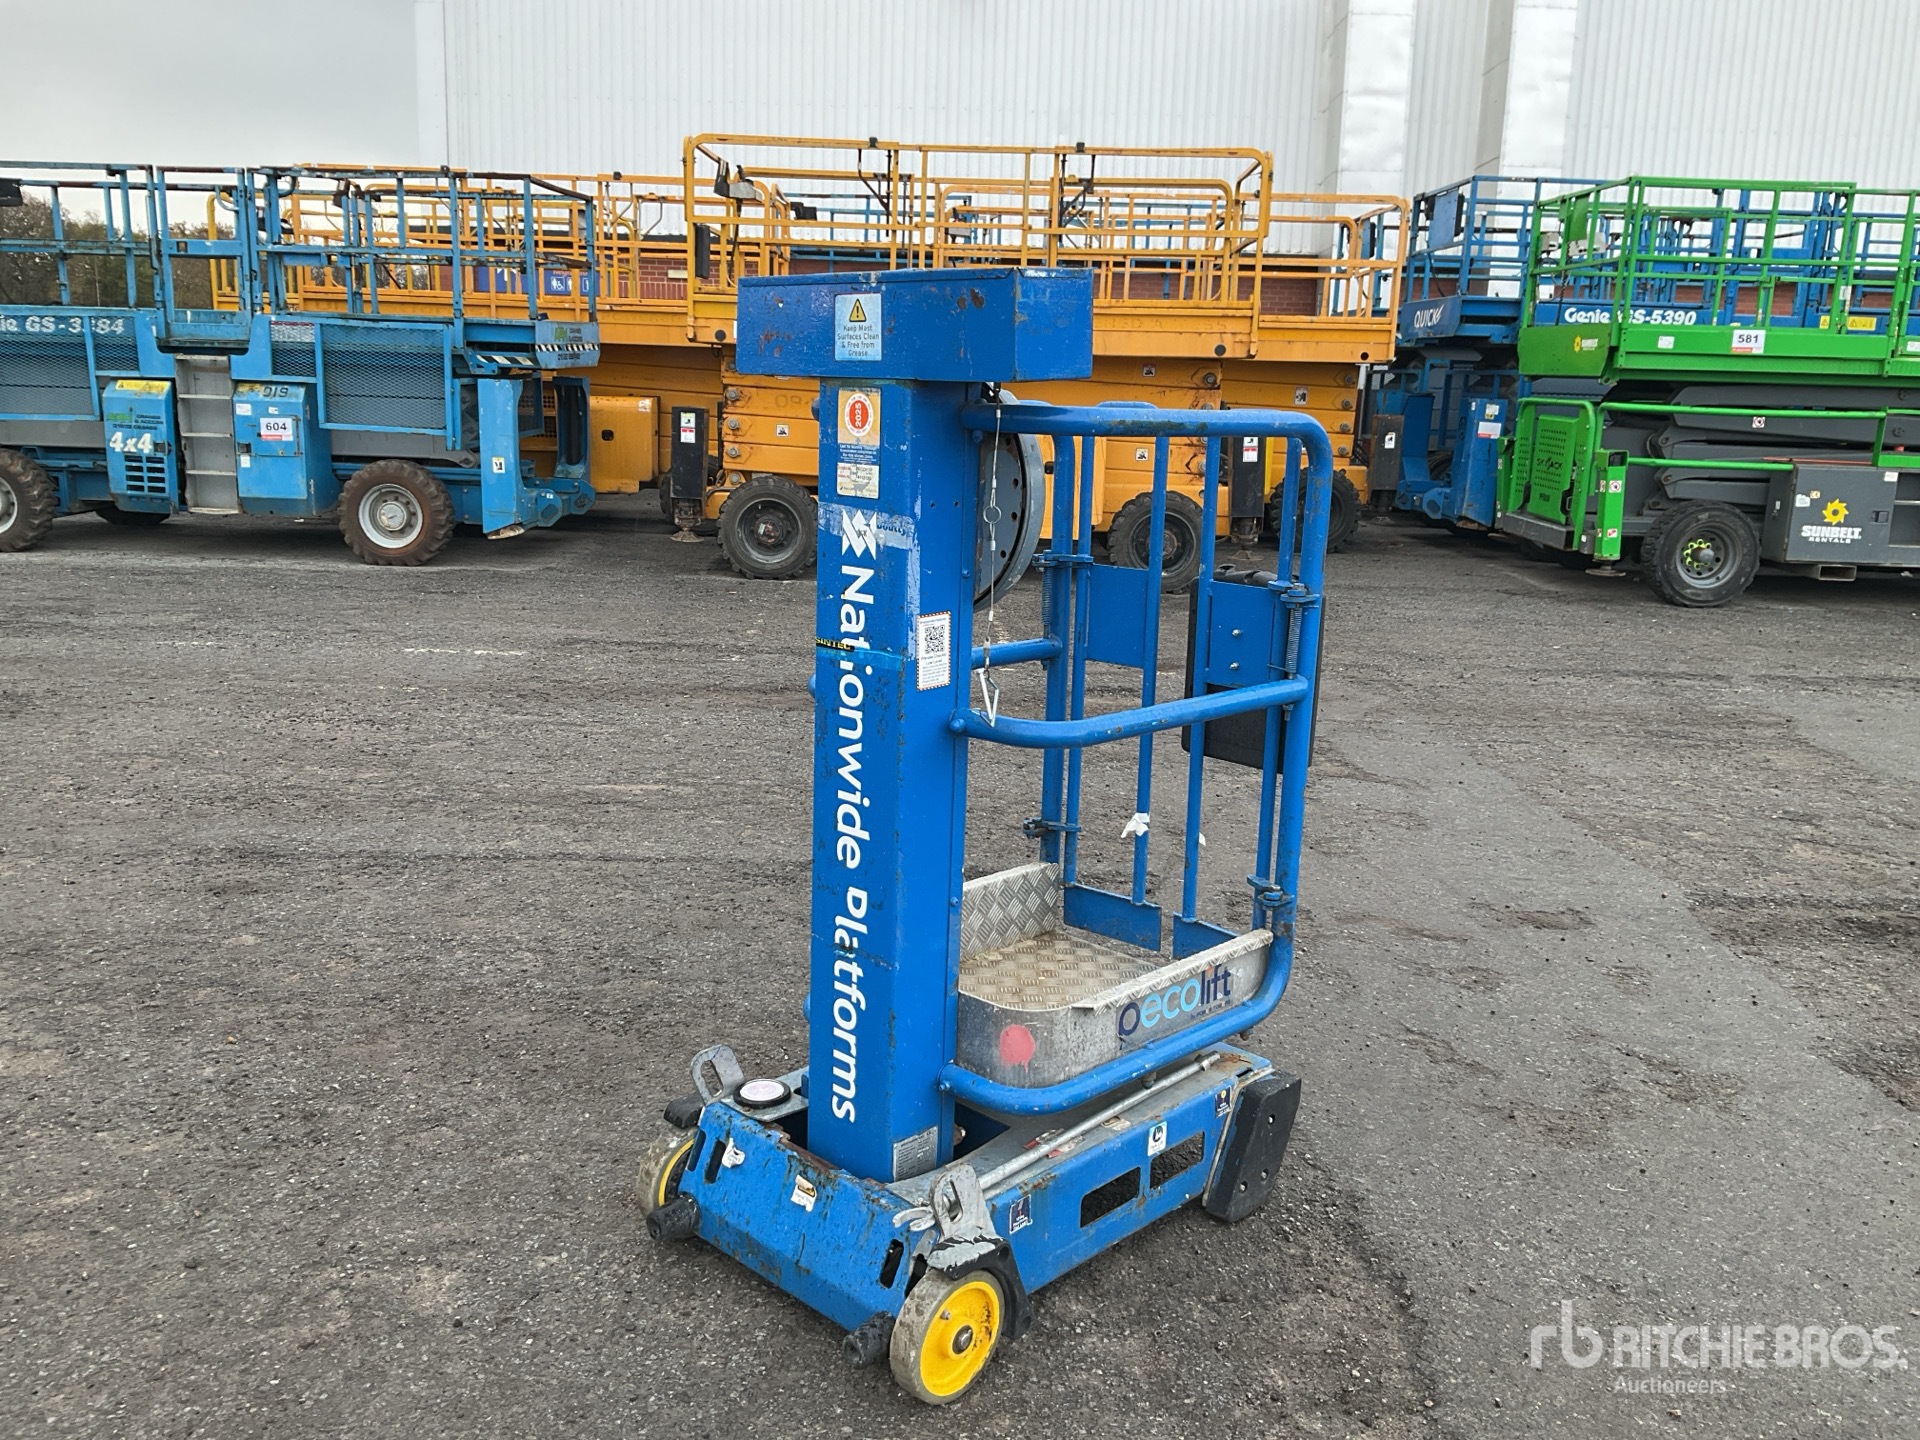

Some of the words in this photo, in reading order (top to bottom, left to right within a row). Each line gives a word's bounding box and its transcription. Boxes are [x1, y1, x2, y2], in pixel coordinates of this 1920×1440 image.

[1563, 307, 1611, 324] Genie
[25, 316, 125, 335] GS-384
[858, 324, 873, 332] Mast
[837, 332, 862, 340] Surfaces
[863, 332, 880, 340] Clean
[1737, 333, 1760, 344] 581
[847, 341, 860, 349] Free
[861, 341, 875, 349] from
[854, 402, 862, 428] 2025
[265, 422, 287, 431] 604
[109, 431, 153, 454] 4x4
[836, 565, 875, 870] Nationwide
[831, 886, 869, 1124] Platforms
